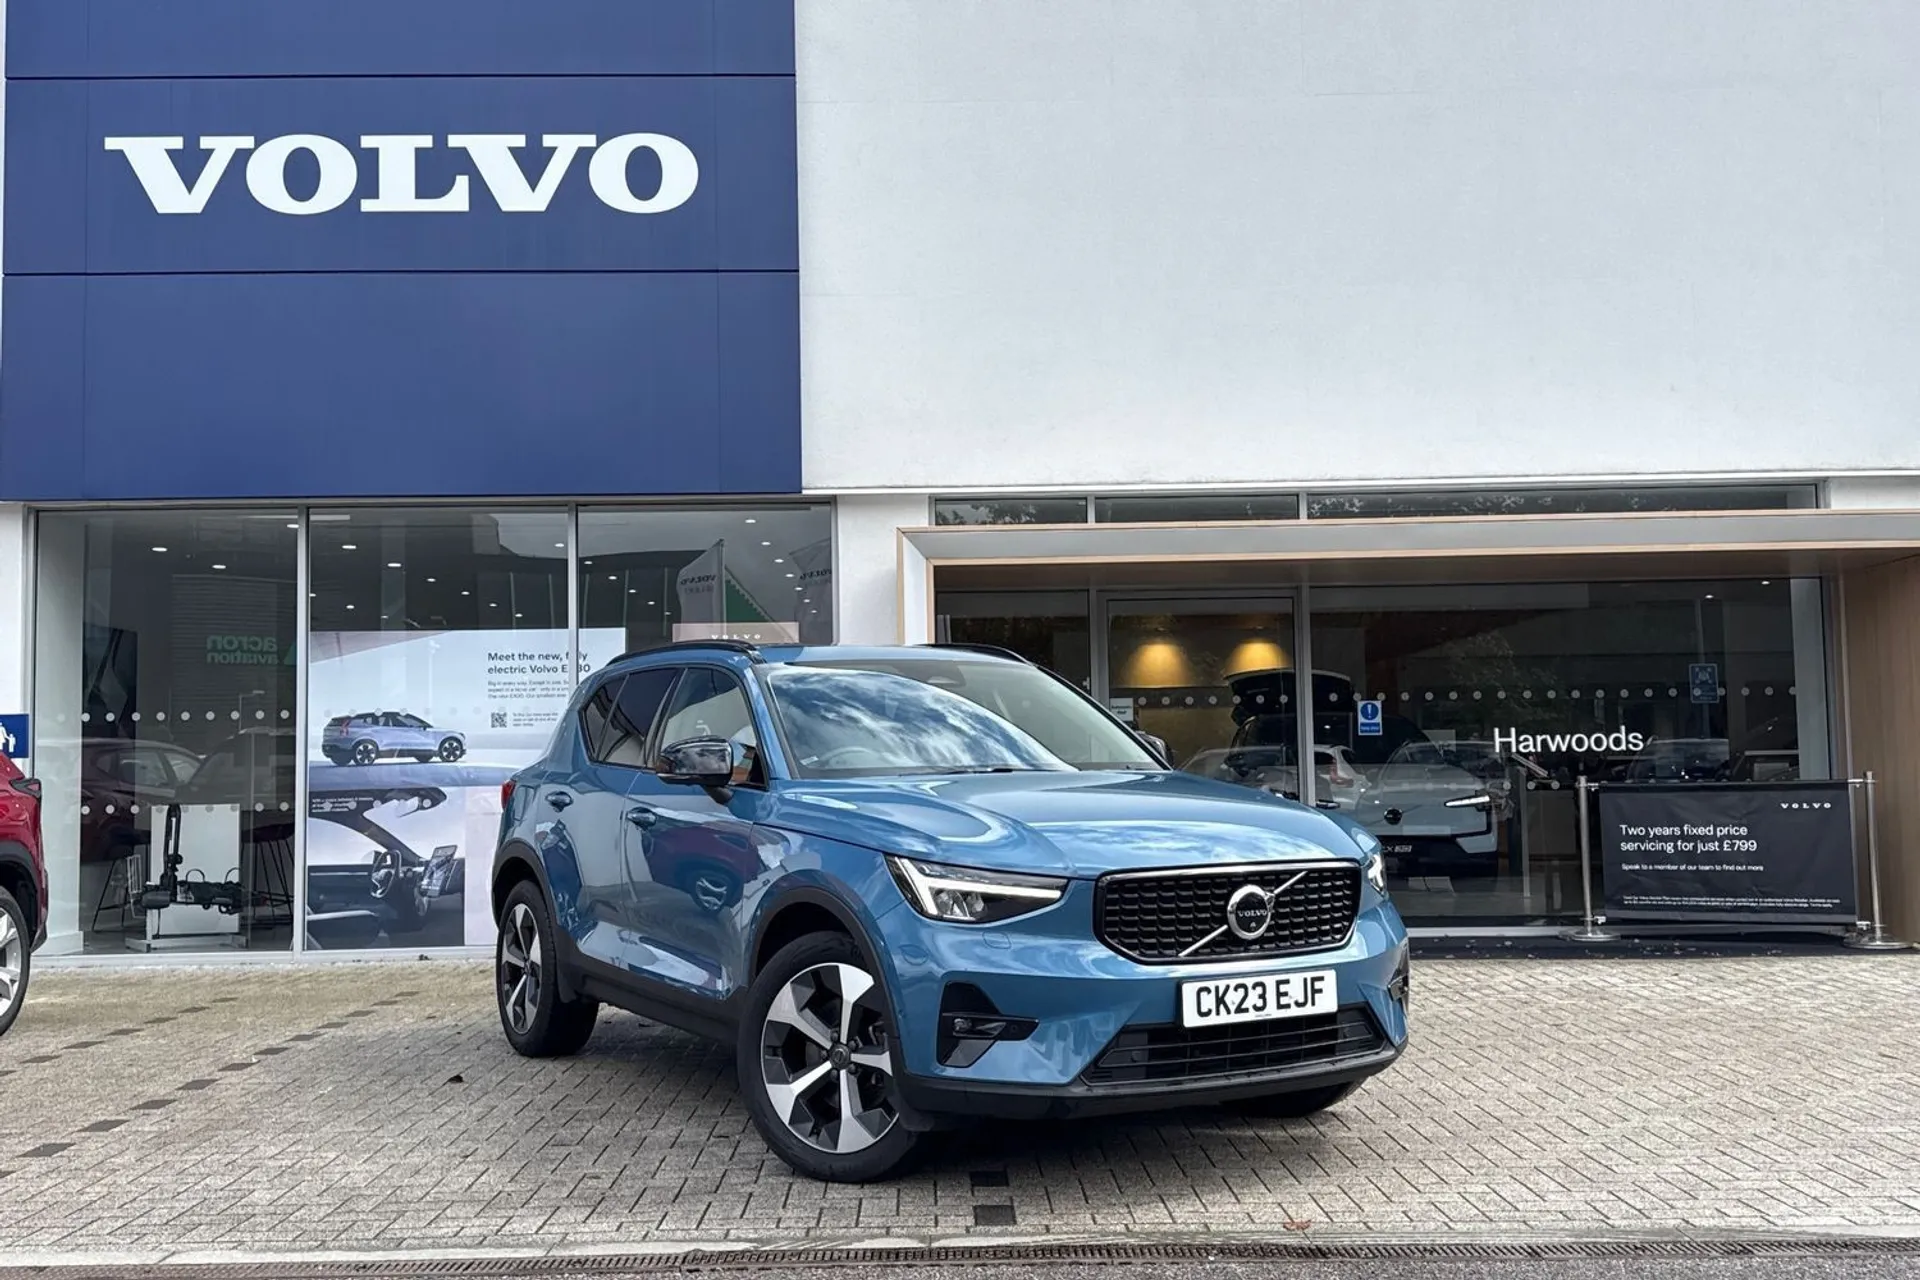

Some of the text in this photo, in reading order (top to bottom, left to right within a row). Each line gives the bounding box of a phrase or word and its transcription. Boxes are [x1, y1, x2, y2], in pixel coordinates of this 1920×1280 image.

[104, 133, 699, 215] VOLVO
[488, 652, 515, 661] Meet
[518, 652, 535, 661] the
[537, 653, 563, 663] new,
[488, 663, 591, 674] electric Volvo E30
[1493, 725, 1644, 753] Harwoods
[1619, 824, 1749, 838] Two years fixed price
[1620, 840, 1758, 854] servicing for just £799
[1237, 909, 1268, 917] VOLVO
[1195, 976, 1325, 1017] CK23 EJF
